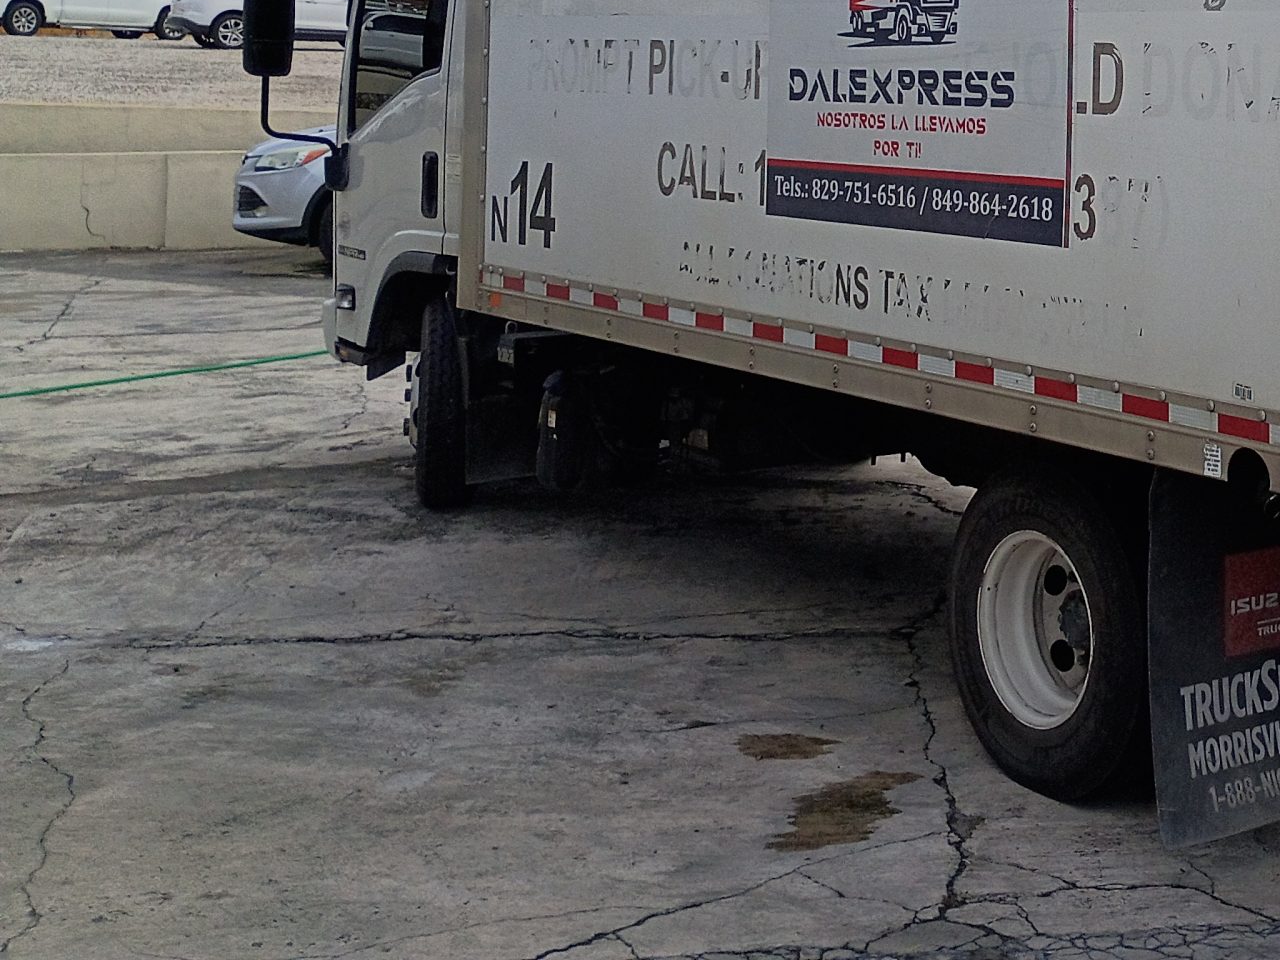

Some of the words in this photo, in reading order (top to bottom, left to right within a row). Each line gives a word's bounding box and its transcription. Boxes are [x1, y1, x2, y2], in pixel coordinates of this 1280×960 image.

[788, 68, 1016, 108] DALEXPRESS
[816, 112, 886, 130] NOSOTROS
[891, 116, 910, 131] LA
[915, 116, 987, 135] LLEVAMOS
[873, 140, 899, 157] POR
[774, 175, 809, 198] Tels.:
[811, 178, 916, 208] 829-751-6516
[931, 188, 1053, 221] 849-864-2618
